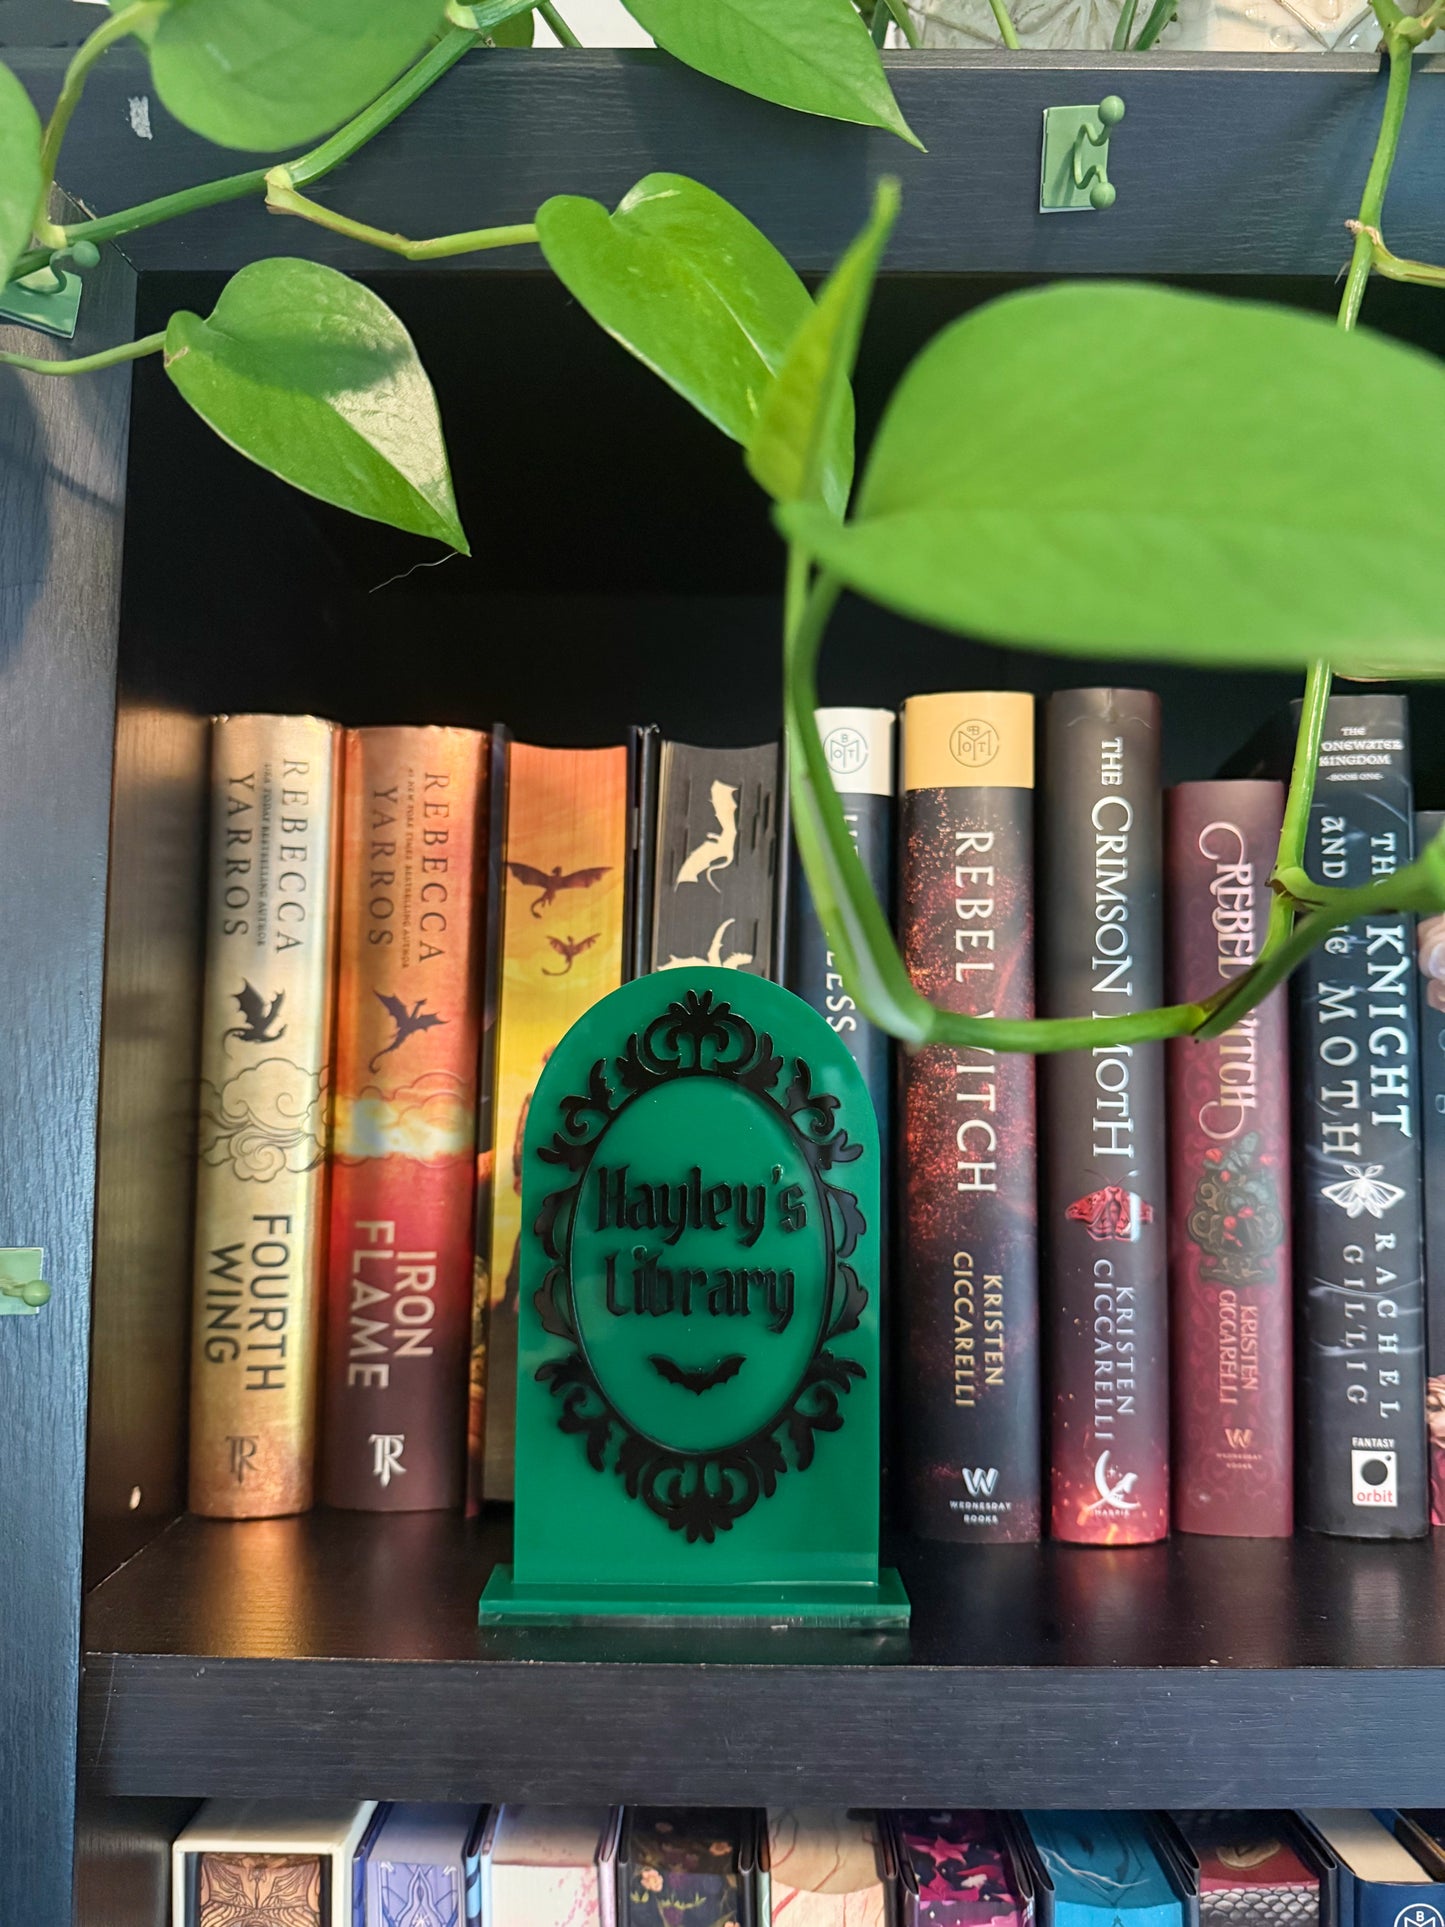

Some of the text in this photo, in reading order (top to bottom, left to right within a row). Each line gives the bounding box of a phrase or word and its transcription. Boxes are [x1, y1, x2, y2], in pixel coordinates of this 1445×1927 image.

[1101, 737, 1123, 785] THE
[1319, 754, 1392, 767] KINGDOM
[1321, 739, 1404, 752] ONEWATER
[1341, 726, 1366, 736] THE
[223, 772, 255, 936] YARROS
[276, 758, 310, 953] REBECCA
[368, 786, 398, 945] YARROS
[419, 772, 450, 962] REBECCA
[954, 831, 995, 984] REBEL
[1091, 796, 1133, 996] CRIMSON
[1200, 821, 1256, 979] REBEL
[1366, 832, 1412, 1138] TH KNIGHT
[1318, 981, 1362, 1156] MOTH
[595, 1164, 807, 1248] Hayley's
[204, 1242, 245, 1364] WING
[245, 1214, 291, 1391] FOURTH
[348, 1220, 395, 1389] FLAME
[393, 1251, 437, 1357] IRON
[604, 1245, 796, 1334] Library
[953, 1251, 976, 1408] CICCARELLI
[983, 1274, 1004, 1386] KRISTEN
[1093, 1259, 1116, 1440] CICCARELLI
[1116, 1286, 1135, 1415] KRISTEN
[1218, 1289, 1238, 1405] CICCARELLI
[1240, 1306, 1258, 1391] KRISTEN
[1343, 1244, 1368, 1404] GILLIG
[1374, 1233, 1400, 1418] RACHEL
[949, 1500, 1012, 1511] WEDNESDAY
[1352, 1437, 1395, 1449] FANTASY
[1357, 1489, 1393, 1503] orbit
[963, 1514, 999, 1524] BOOKS
